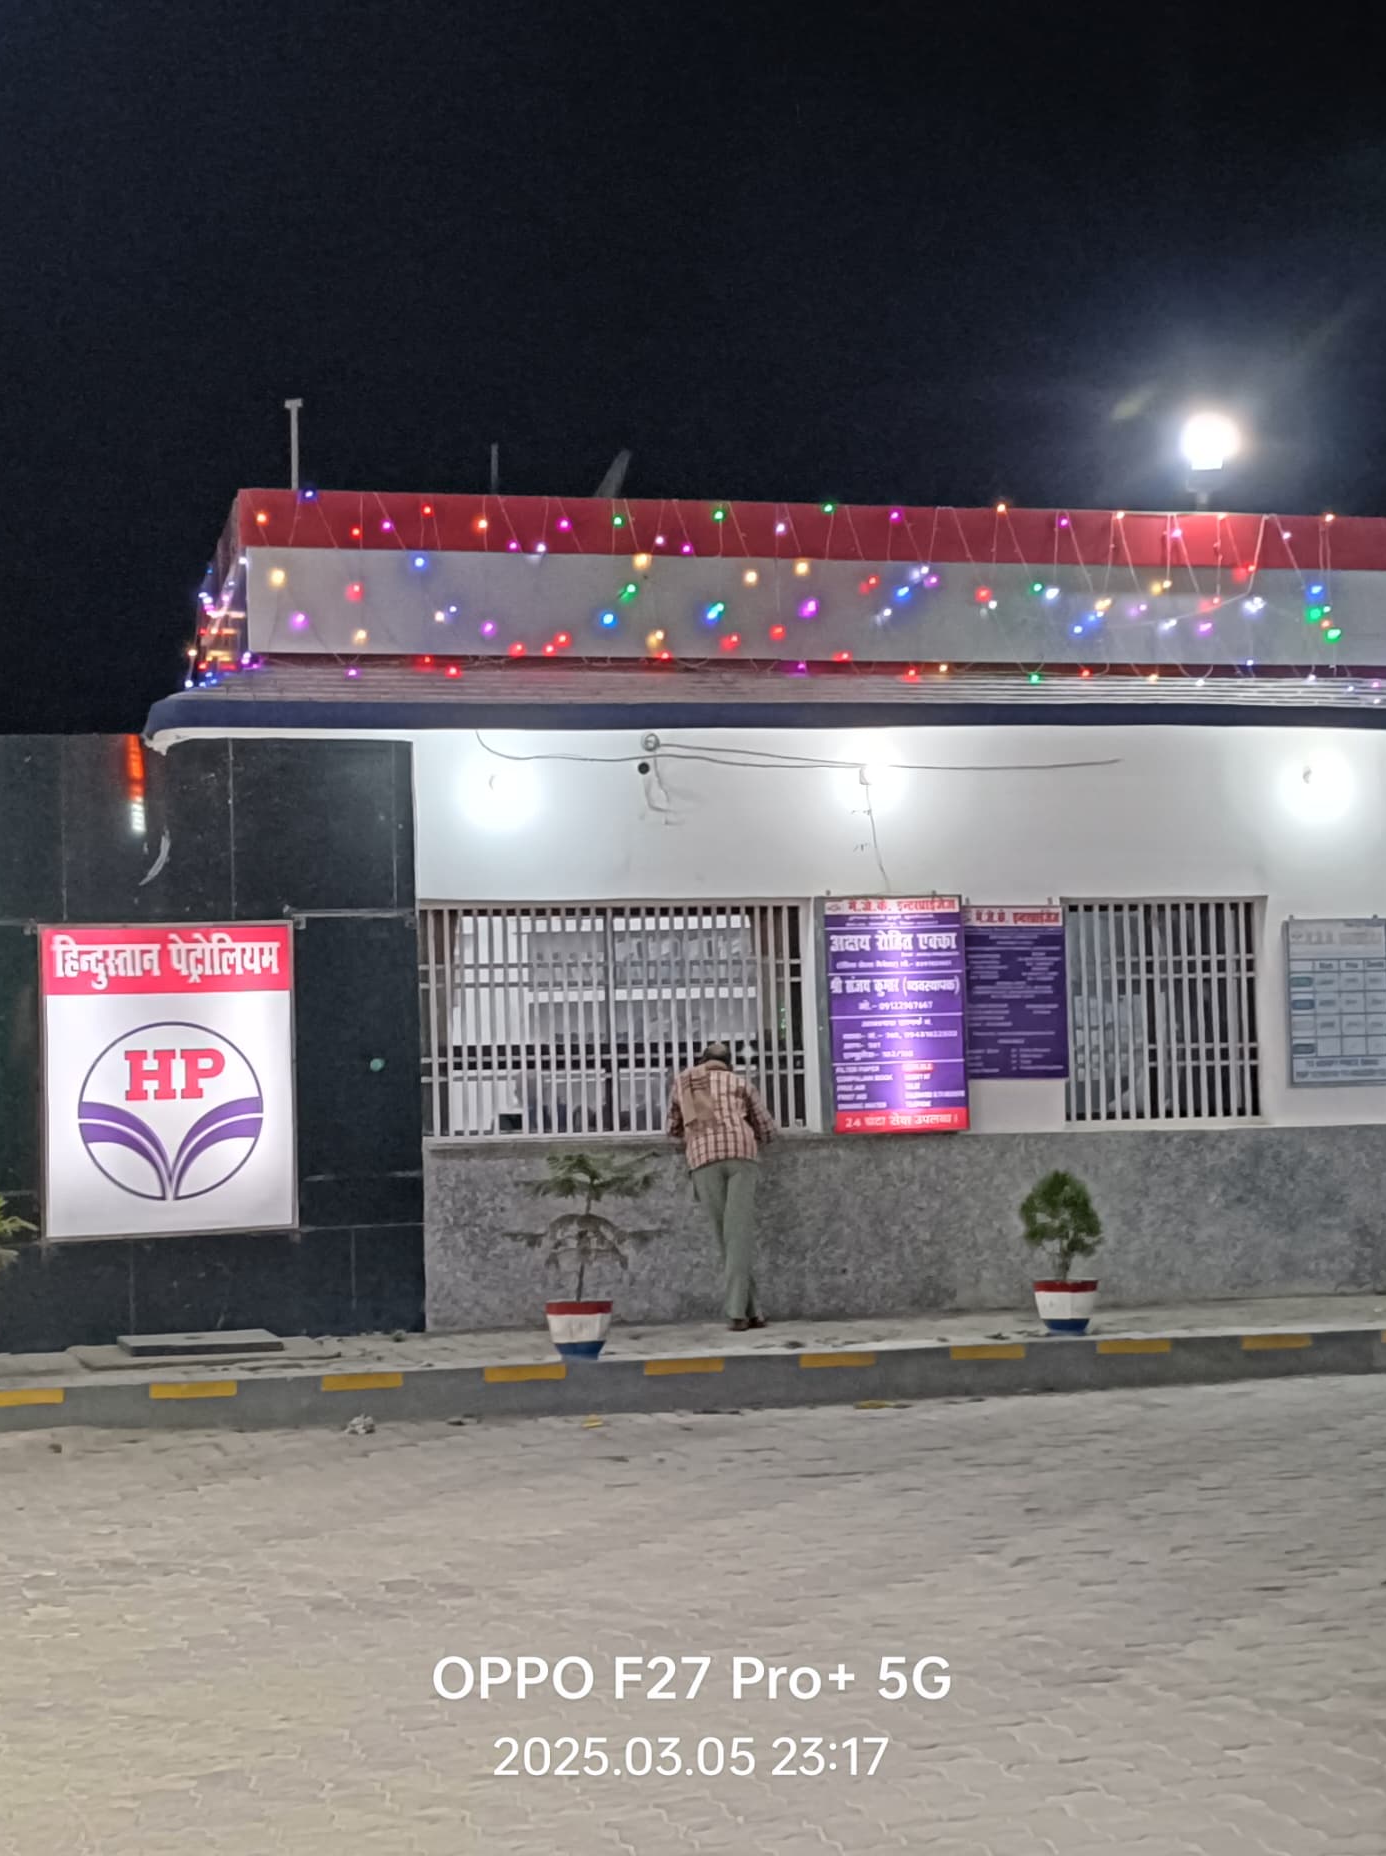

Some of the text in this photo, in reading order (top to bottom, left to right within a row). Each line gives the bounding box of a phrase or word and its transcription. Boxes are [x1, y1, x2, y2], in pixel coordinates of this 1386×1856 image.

[875, 930, 914, 951] रोहित
[917, 932, 957, 949] एक्का
[51, 933, 280, 990] हिन्दुस्तान पेट्रोलियम
[830, 976, 843, 994] श्री
[125, 1048, 225, 1101] HP
[845, 1118, 861, 1129] 24
